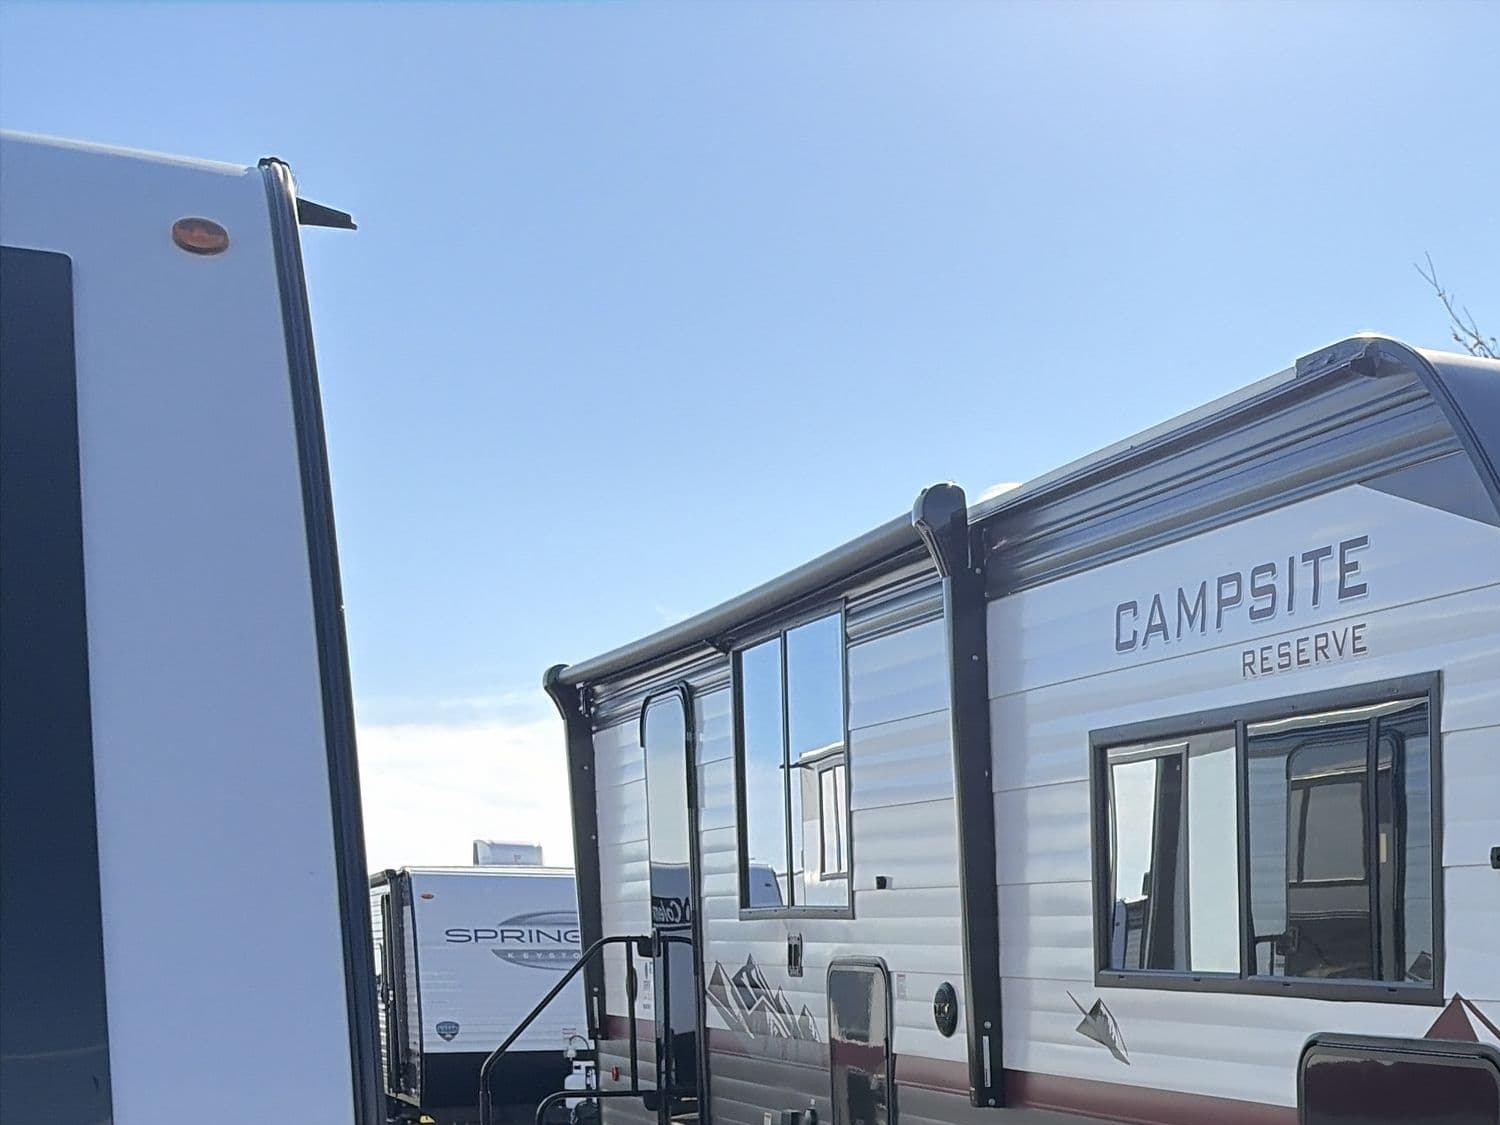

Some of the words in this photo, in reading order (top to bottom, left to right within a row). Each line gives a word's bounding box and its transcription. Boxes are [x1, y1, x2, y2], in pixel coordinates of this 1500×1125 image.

[1114, 534, 1370, 653] CAMPSITE
[1241, 623, 1368, 678] RESERVE
[445, 928, 580, 943] SPRING
